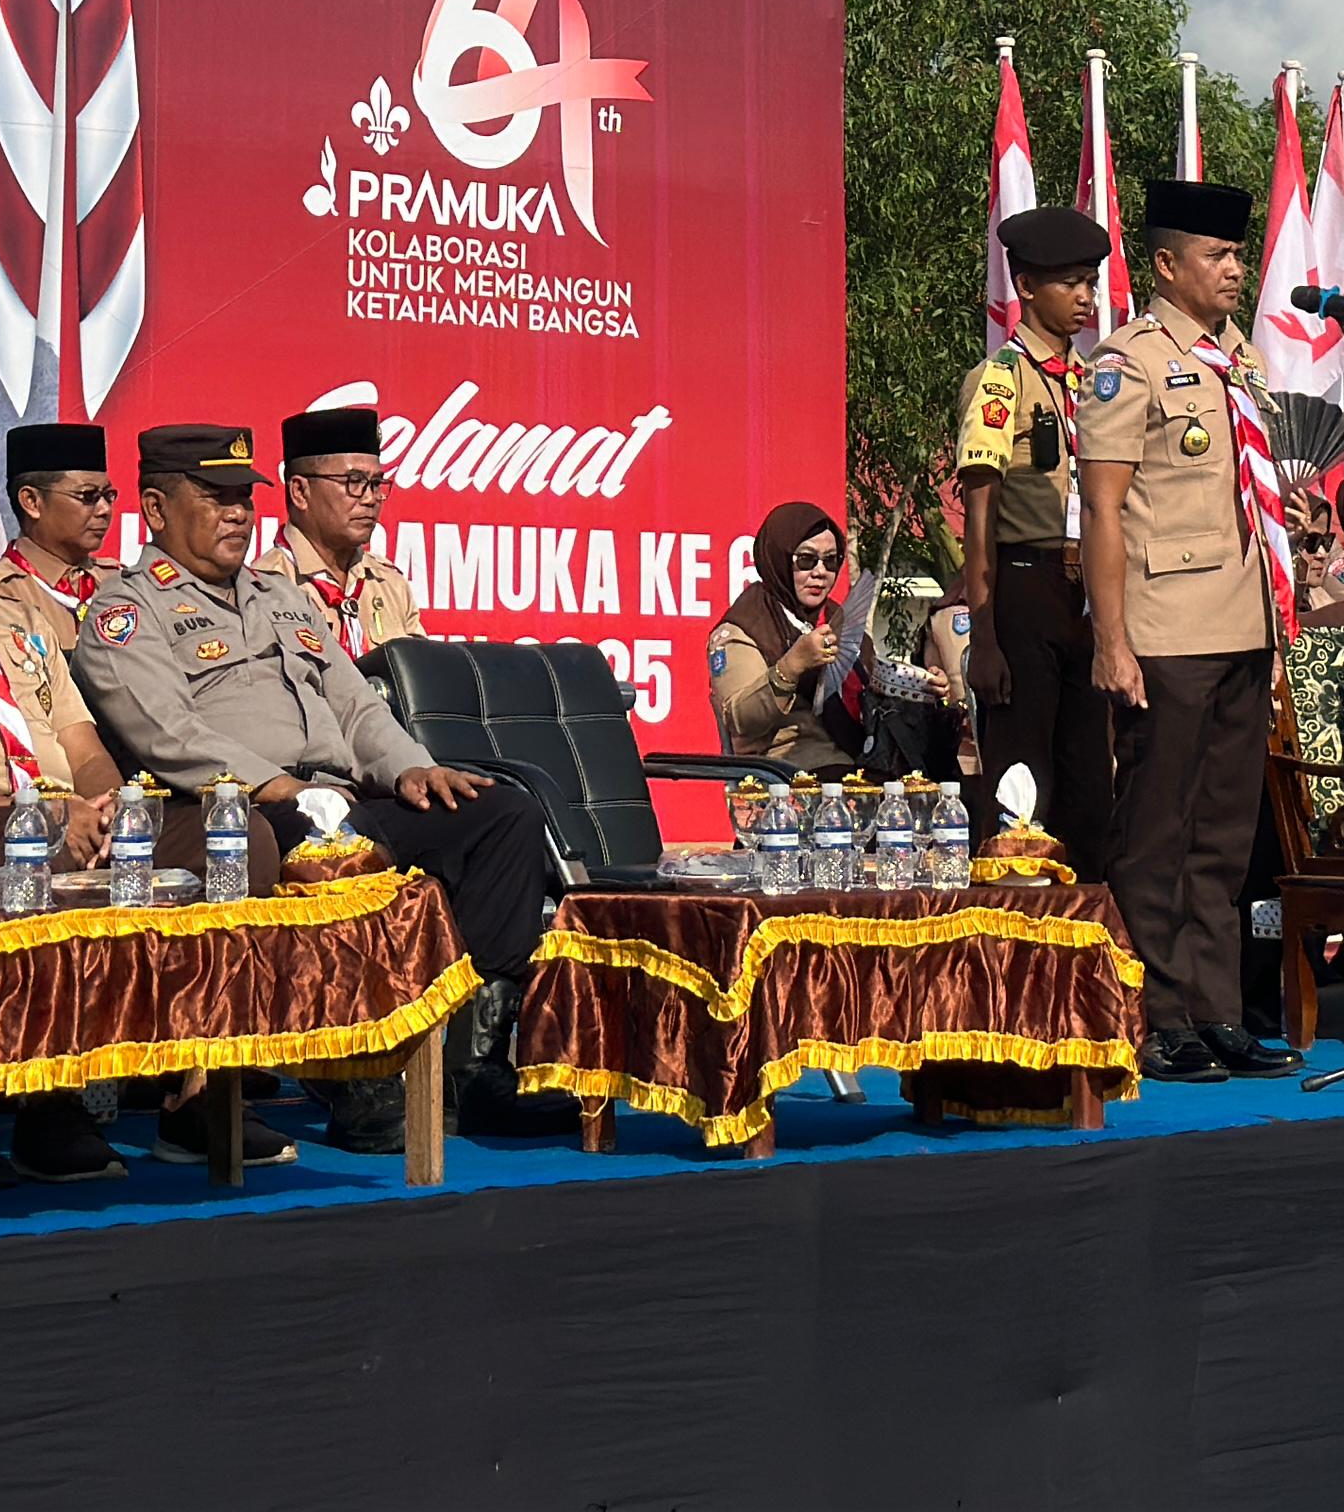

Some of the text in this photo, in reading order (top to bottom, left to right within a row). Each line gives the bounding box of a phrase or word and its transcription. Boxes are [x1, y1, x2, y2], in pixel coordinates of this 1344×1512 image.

[350, 169, 566, 237] PRAMUKA
[348, 228, 527, 271] KOLABORASI
[347, 259, 632, 308] UNTUK MEMBANGUN
[346, 290, 640, 339] KETAHANAN BANGSA
[639, 530, 712, 617] KE
[728, 535, 764, 607] 6
